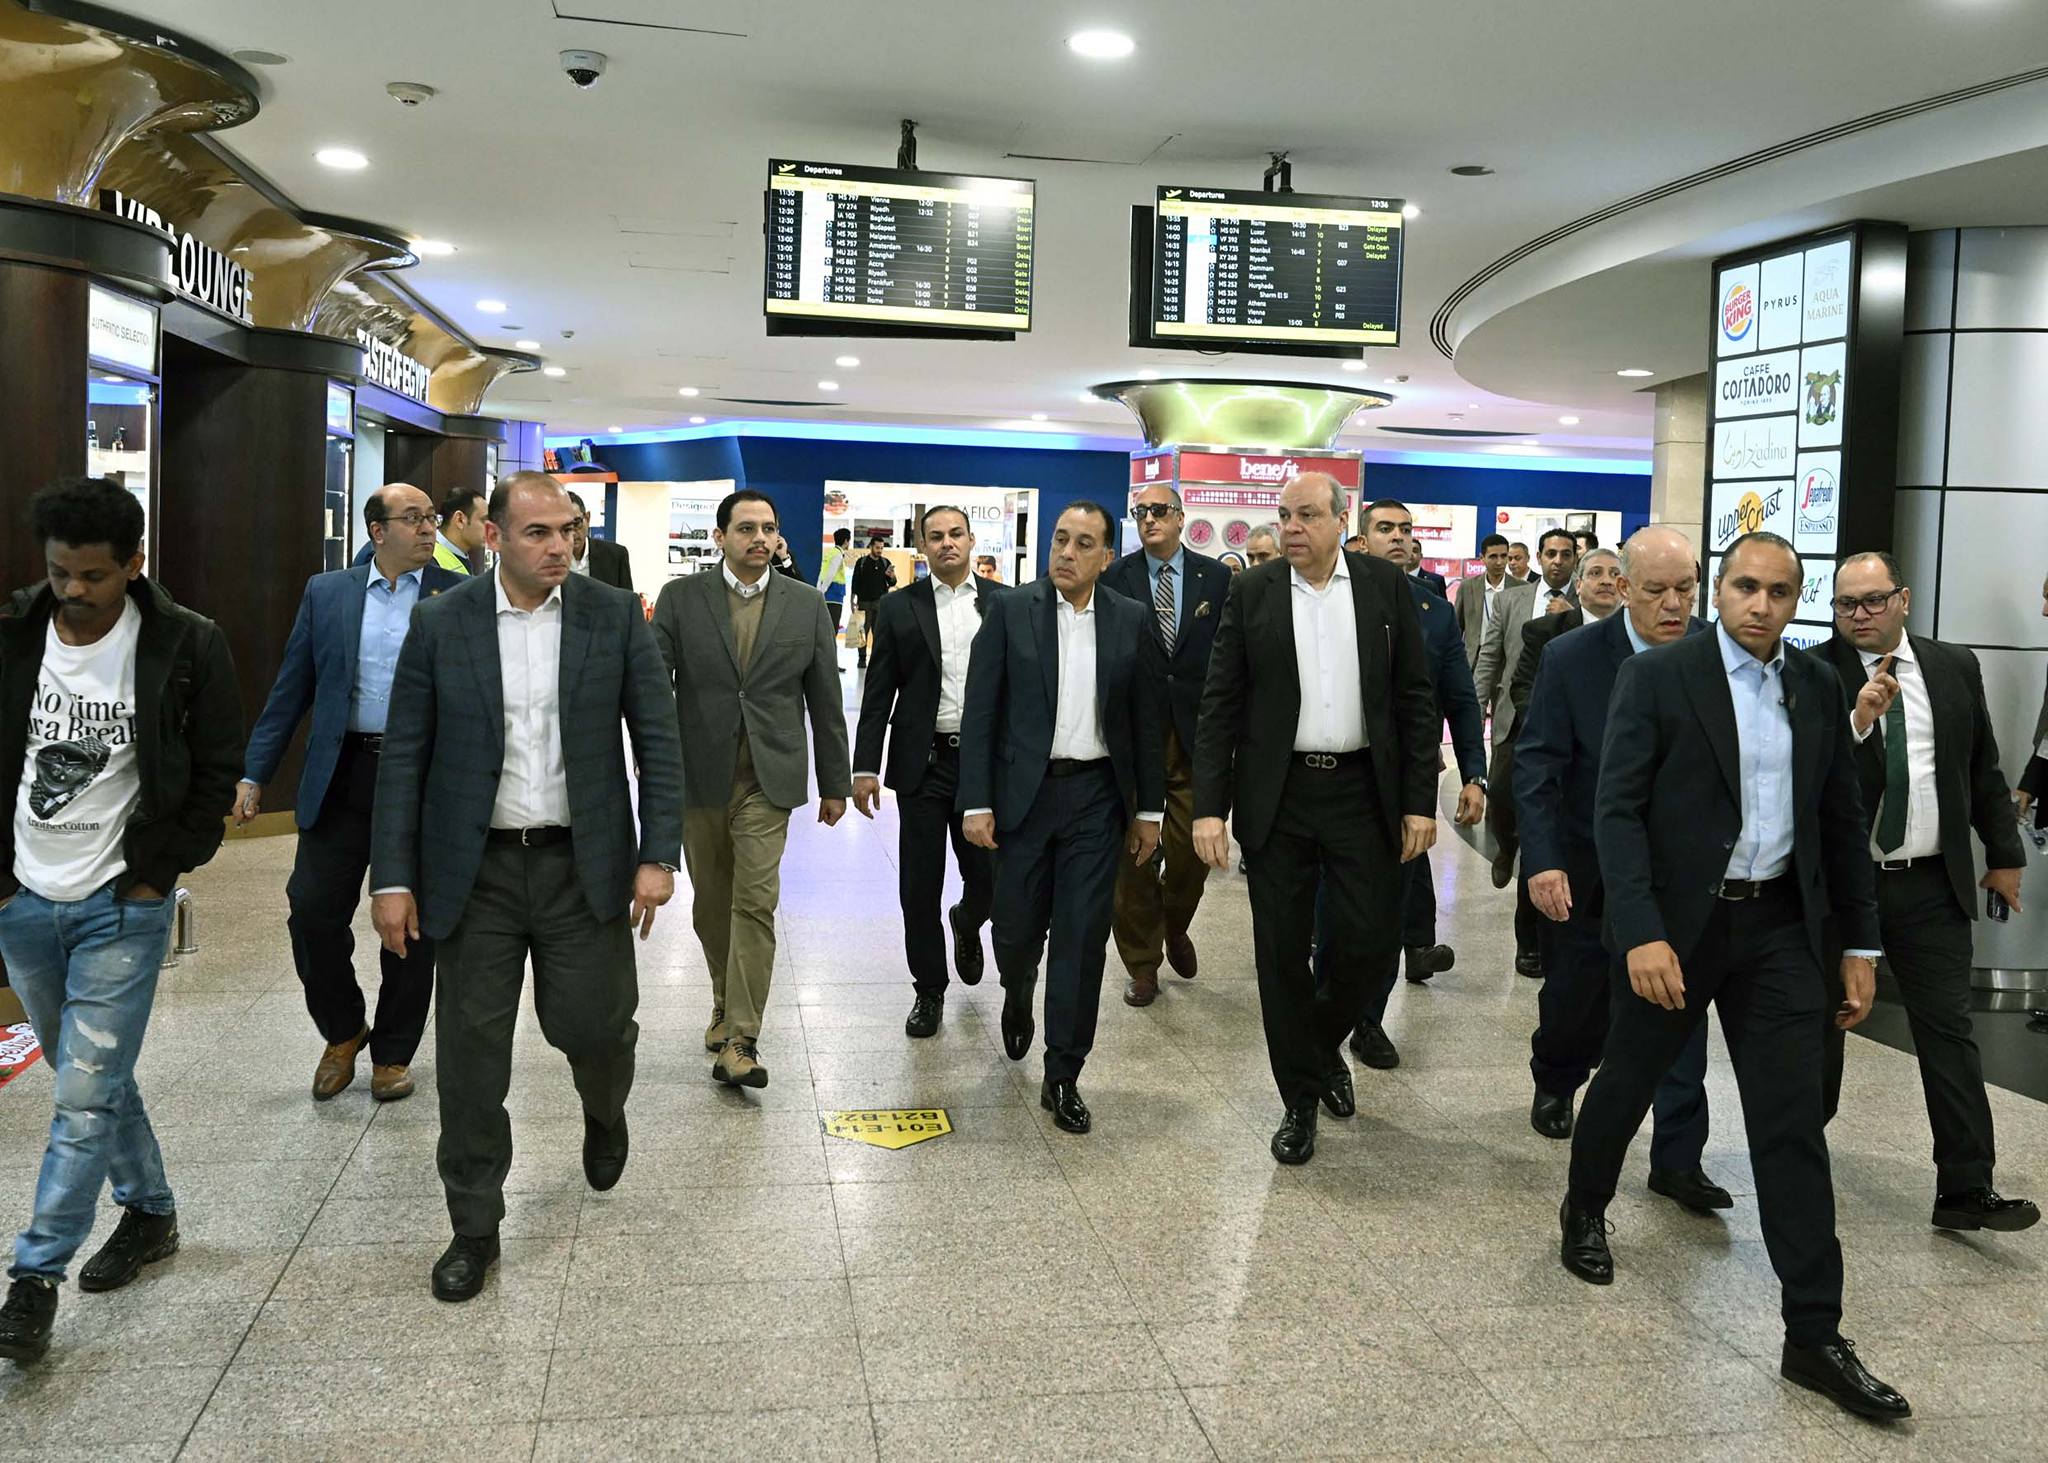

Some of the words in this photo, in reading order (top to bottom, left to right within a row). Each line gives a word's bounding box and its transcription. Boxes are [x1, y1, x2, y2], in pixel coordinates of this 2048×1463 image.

[804, 165, 843, 175] Departures
[778, 198, 794, 206] 12:10
[1189, 190, 1226, 200] Departures
[1371, 200, 1389, 209] 12:36
[778, 207, 794, 215] 12:30
[869, 214, 894, 224] Baghdad
[869, 223, 896, 233] Budapest
[1367, 226, 1387, 234] Delayed
[869, 233, 896, 242] Malpensa
[1366, 234, 1387, 243] Delayed
[868, 242, 901, 250] Amsterdam
[1375, 243, 1389, 252] Open
[776, 253, 792, 261] 13:15
[868, 251, 894, 260] Shanghai
[1249, 246, 1270, 254] Istanbul
[1365, 252, 1386, 261] Delayed
[1249, 255, 1267, 264] Riyadh
[167, 223, 255, 323] LOUNGE
[1248, 264, 1274, 272] Dammam
[867, 278, 894, 286] Frankfurt
[1248, 282, 1273, 291] Hurghada
[867, 287, 883, 295] Dubai
[1812, 288, 1840, 303] AQUA
[1725, 289, 1751, 316] BURGER
[1763, 295, 1798, 311] PYRUS
[1725, 300, 1752, 330] KING
[1807, 303, 1844, 321] MARINE
[1362, 323, 1383, 331] Delayed
[1743, 363, 1770, 377] CAFFE
[402, 355, 431, 404] EGYPT
[1722, 372, 1791, 401] COSTADORO
[1240, 457, 1299, 481] benefit
[1801, 476, 1834, 509] Segafredo
[962, 505, 1001, 520] AFILO
[1718, 499, 1752, 542] upper
[69, 692, 126, 721] Time
